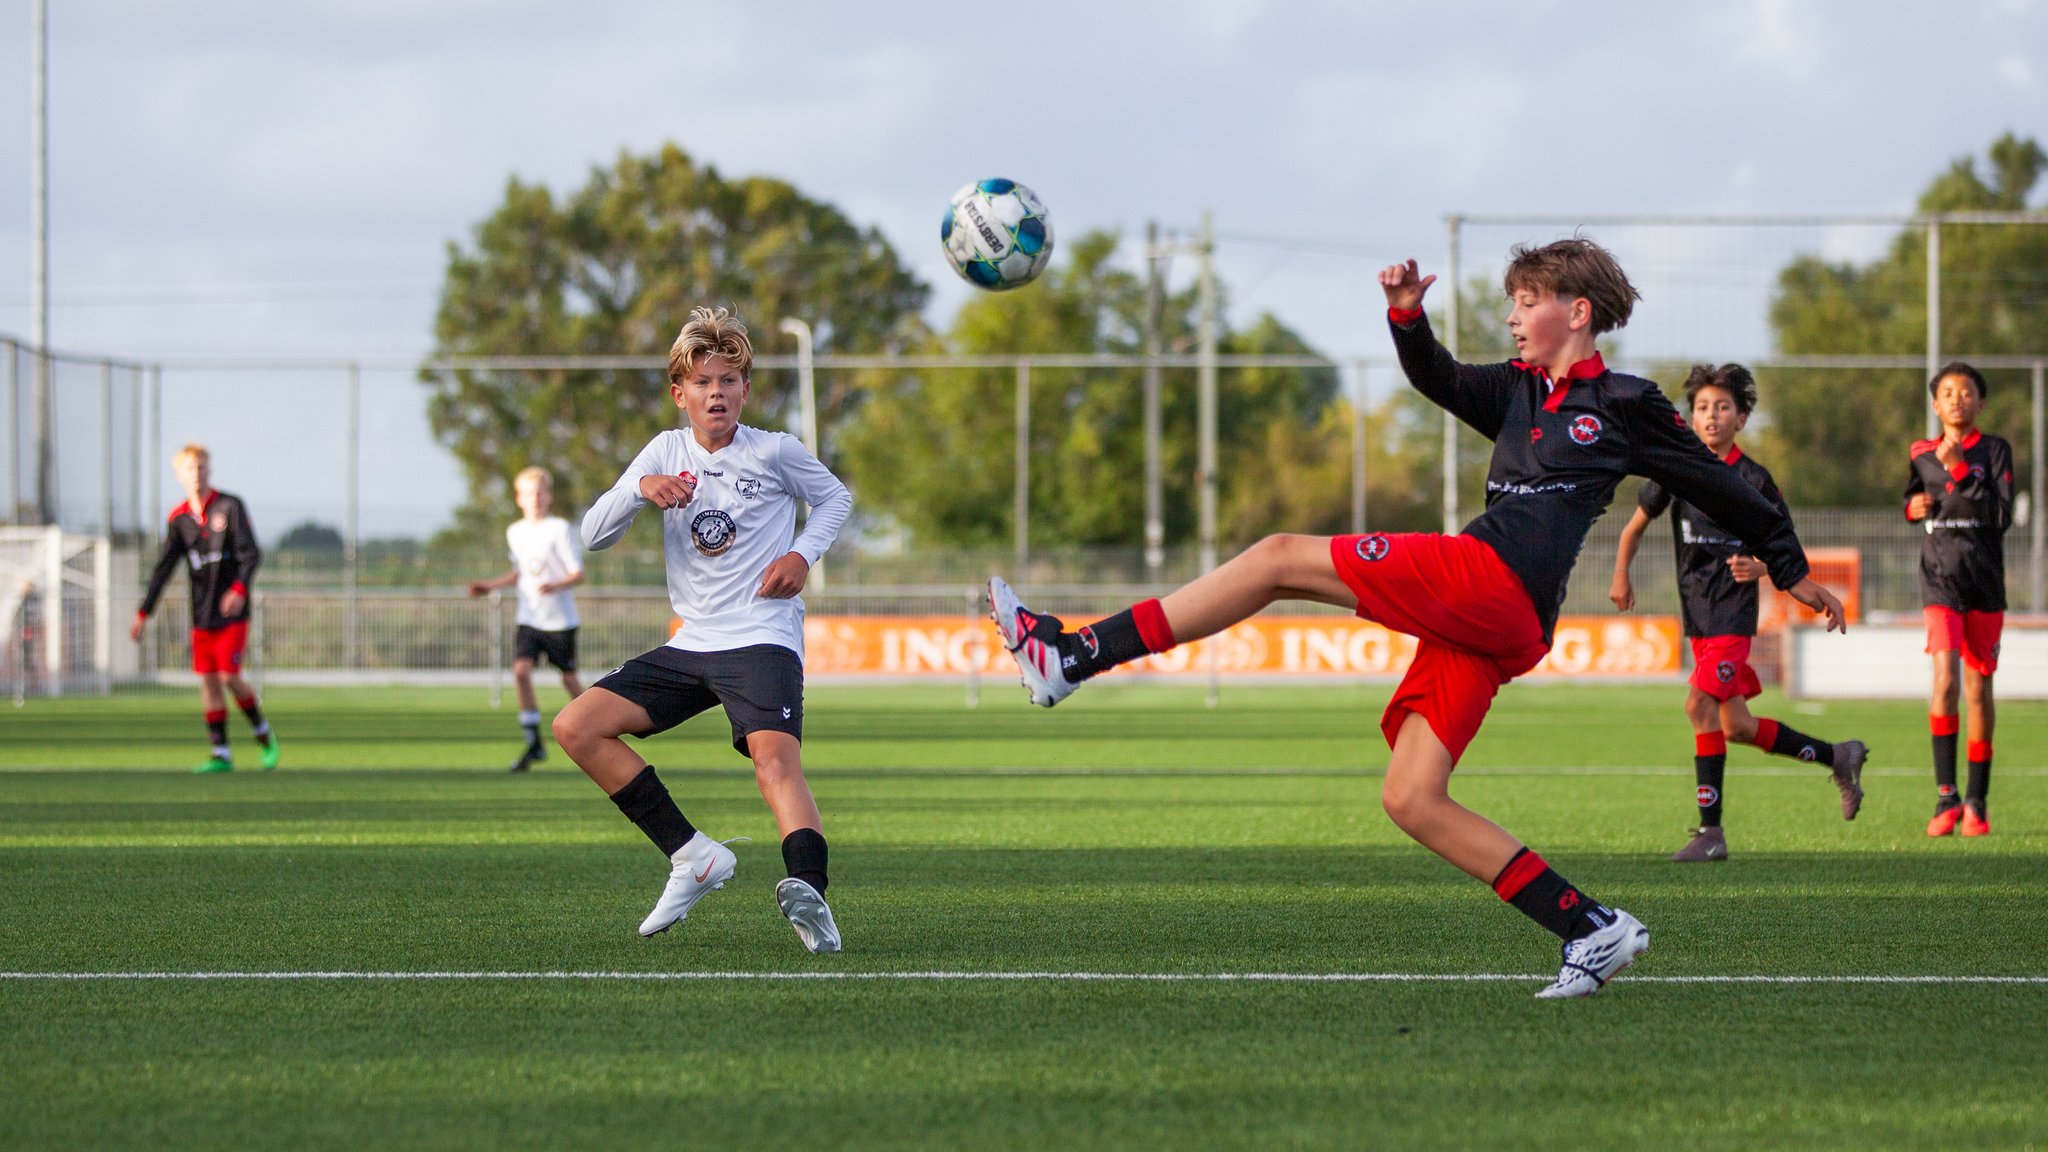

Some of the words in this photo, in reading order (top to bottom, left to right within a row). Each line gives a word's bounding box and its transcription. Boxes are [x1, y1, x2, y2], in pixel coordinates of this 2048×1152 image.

[963, 200, 1005, 254] DERBYSTAR
[882, 628, 988, 672] ING
[1282, 628, 1390, 672] ING
